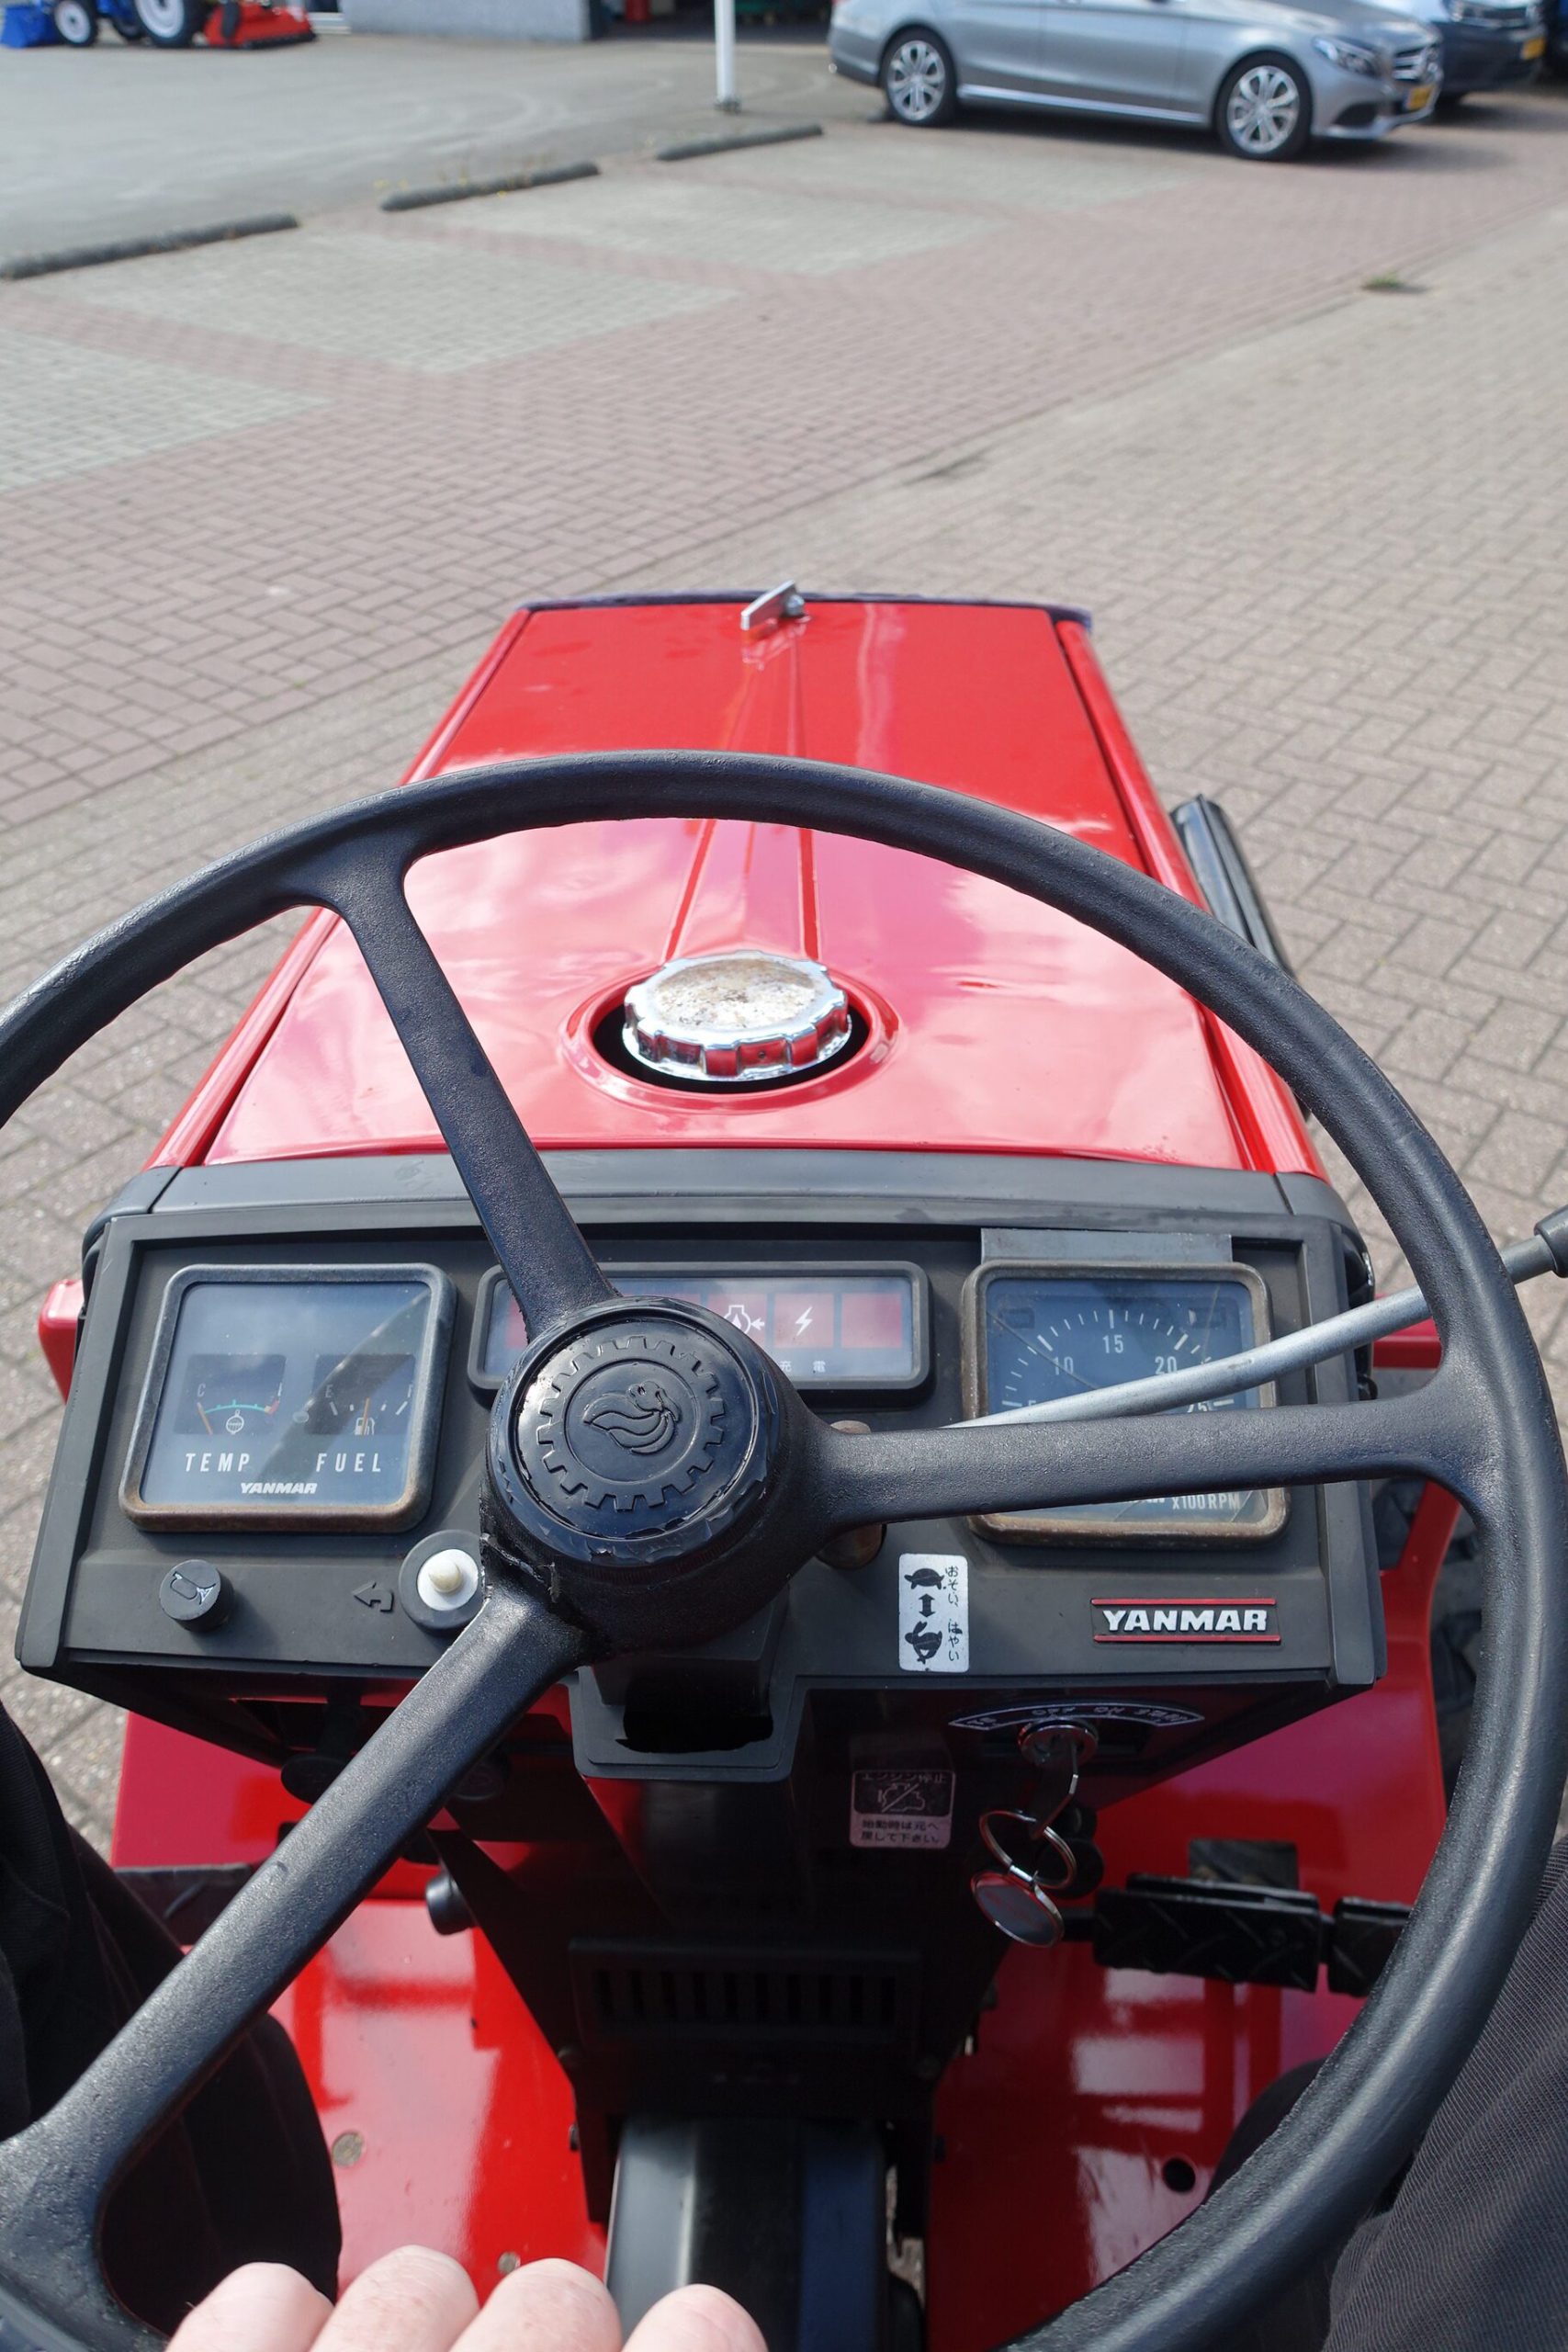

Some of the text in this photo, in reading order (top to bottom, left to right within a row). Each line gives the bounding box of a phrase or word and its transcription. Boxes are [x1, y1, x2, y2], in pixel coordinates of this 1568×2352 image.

[1102, 1335, 1124, 1353] 15
[1054, 1357, 1075, 1376] 10
[1155, 1356, 1178, 1375] 20
[196, 1383, 207, 1397] C
[325, 1384, 334, 1398] E
[185, 1453, 251, 1473] TEMP
[316, 1453, 381, 1473] FUEL
[241, 1482, 318, 1495] YANMAR
[1102, 1609, 1269, 1633] YANMAR
